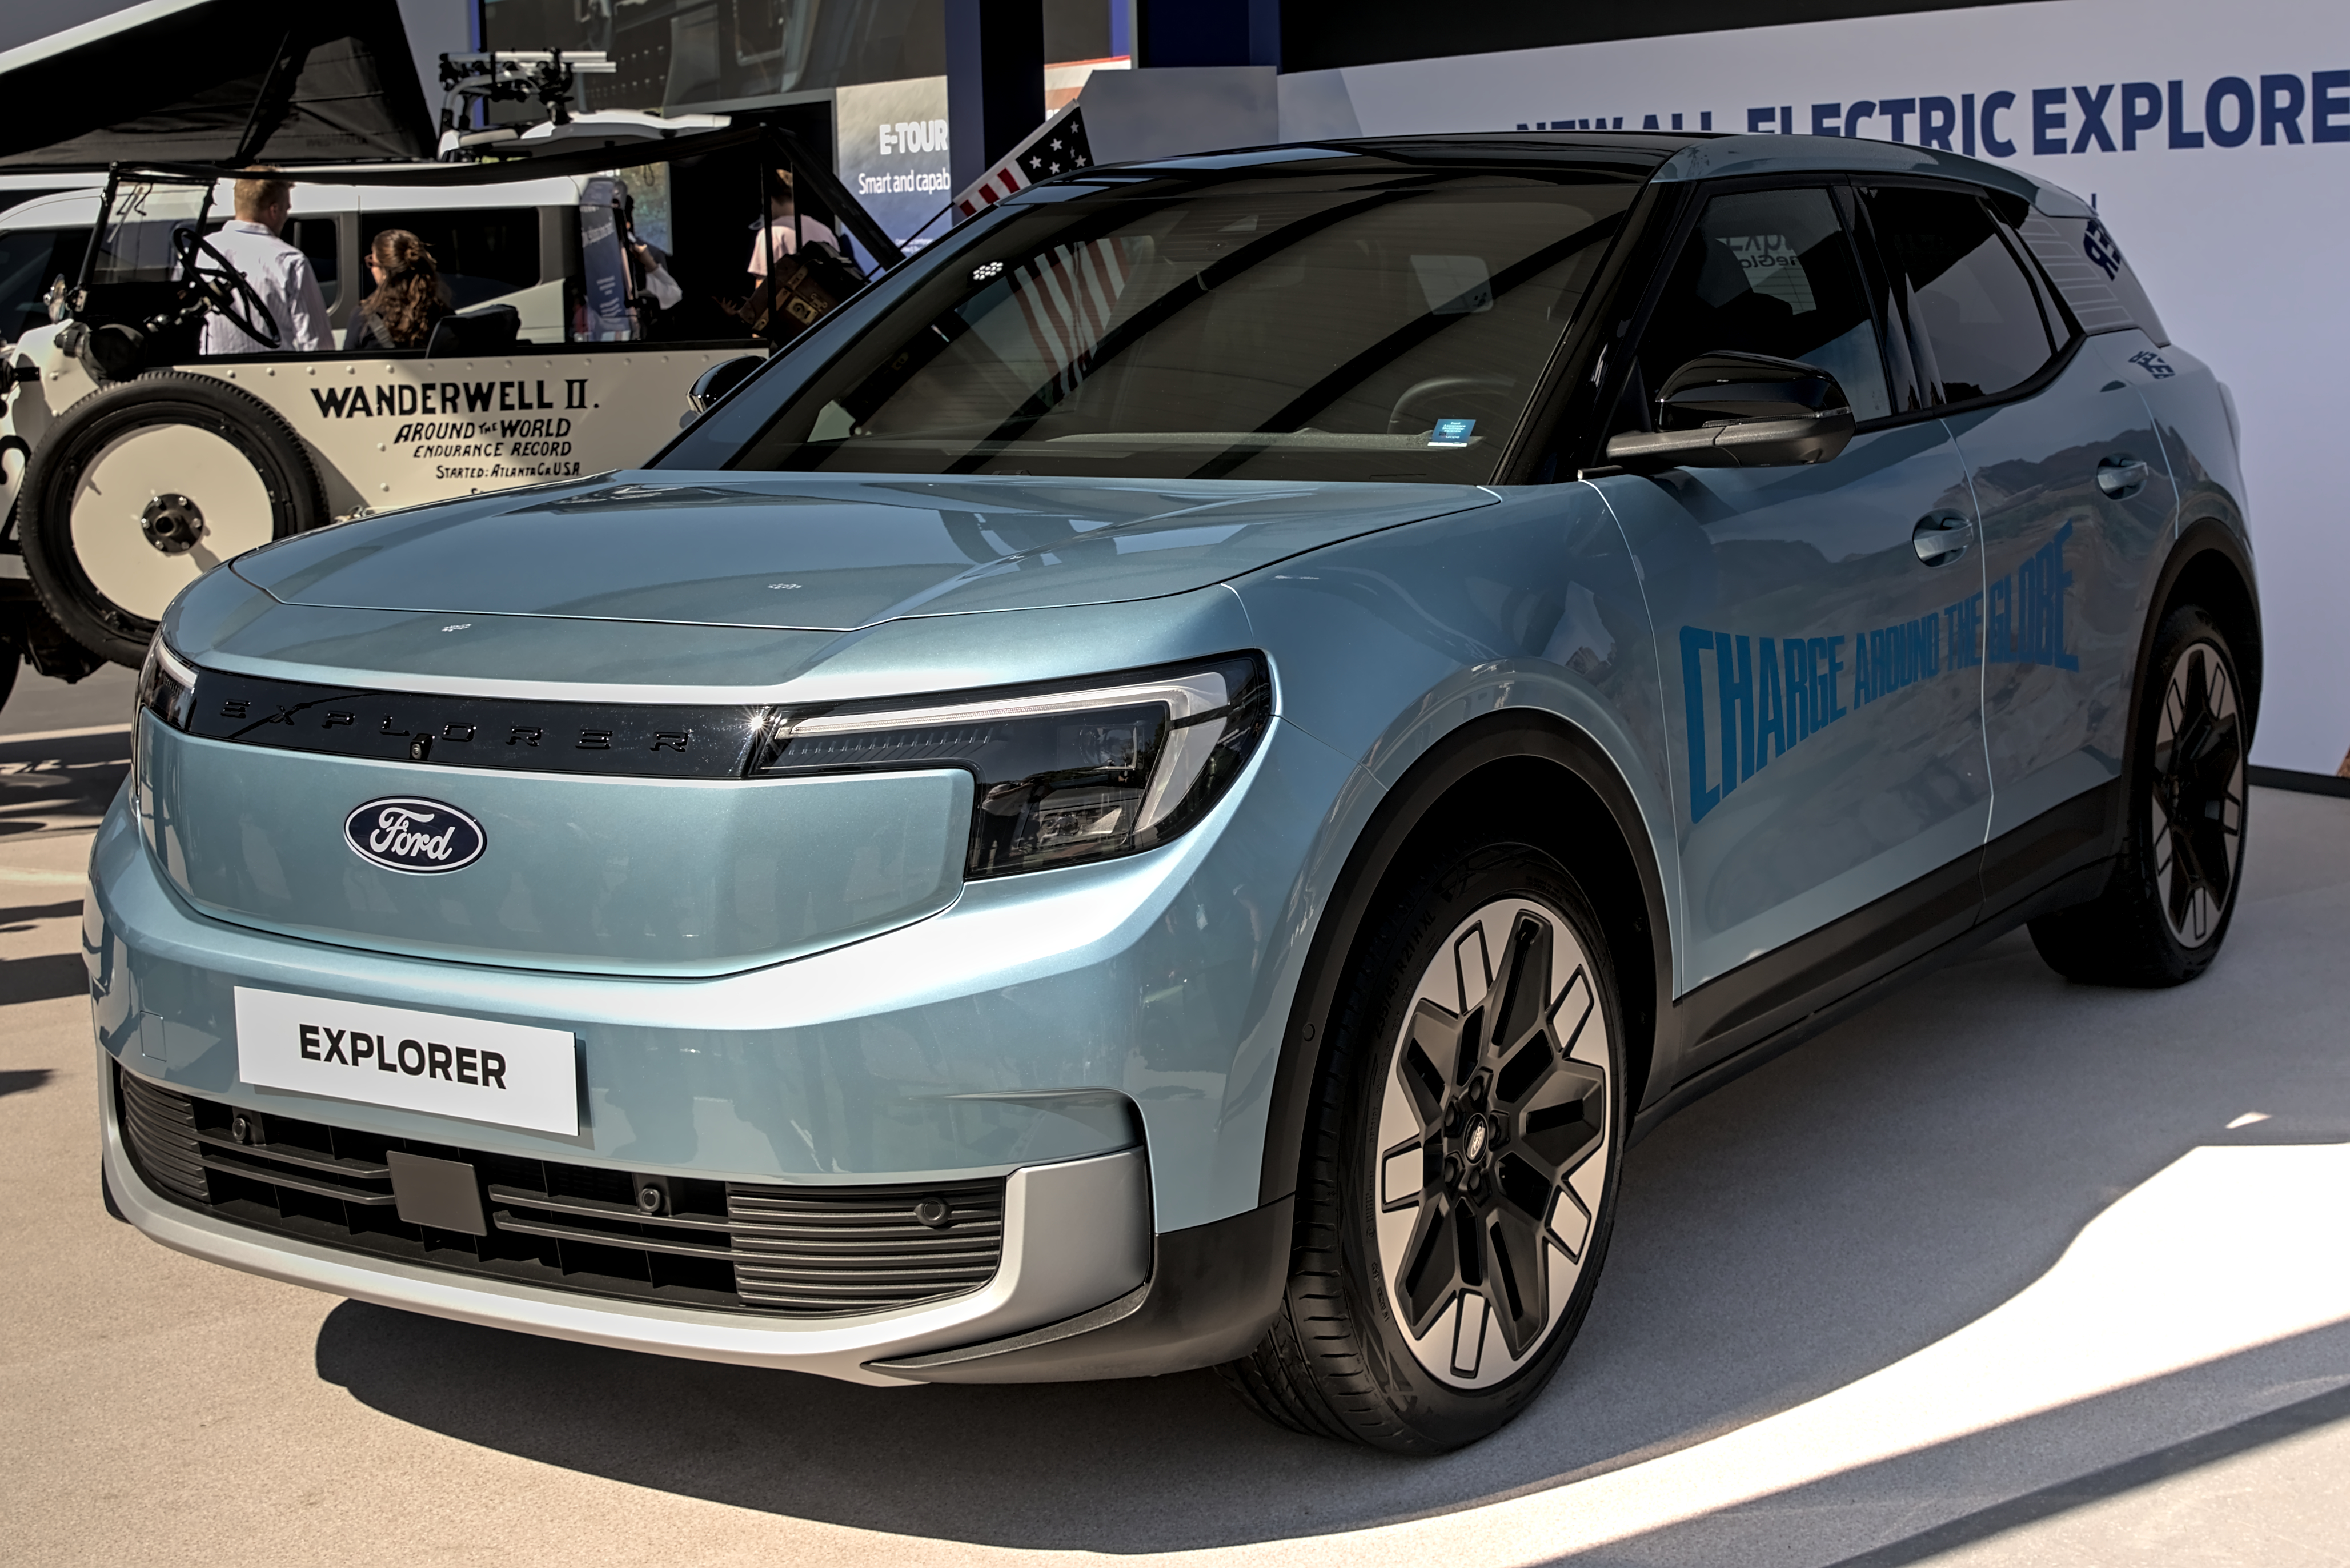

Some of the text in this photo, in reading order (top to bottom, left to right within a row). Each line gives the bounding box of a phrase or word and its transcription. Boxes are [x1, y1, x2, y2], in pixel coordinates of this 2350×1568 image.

[2031, 70, 2350, 156] EXPLORE
[880, 119, 948, 155] E-TOUR
[858, 167, 951, 195] Smart and capab
[310, 380, 554, 419] WANDERWELL
[394, 418, 571, 444] AROUND THE WORLD
[413, 440, 572, 458] ENDURANCE RECORD
[1679, 518, 2079, 824] CHARGE AROUND THE GLOBE
[220, 699, 689, 752] EXPLORER
[370, 806, 455, 861] Ford
[299, 1022, 507, 1090] EXPLORER
